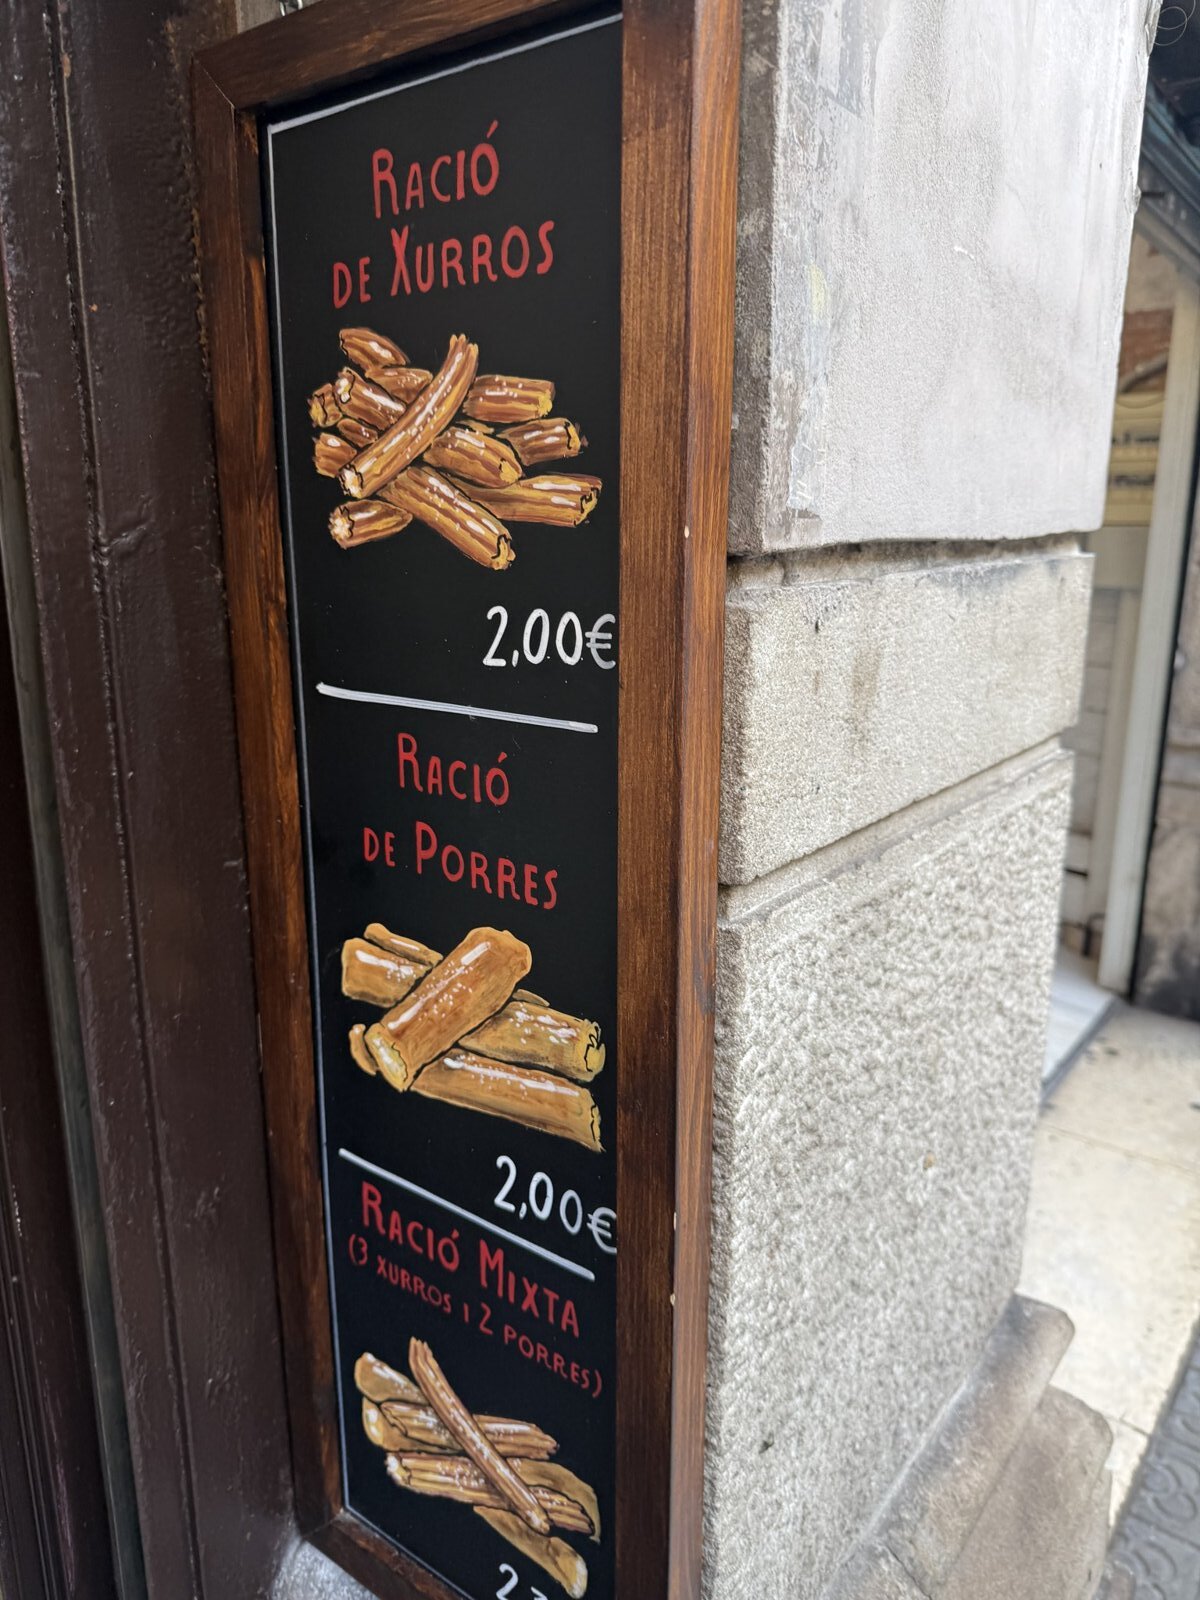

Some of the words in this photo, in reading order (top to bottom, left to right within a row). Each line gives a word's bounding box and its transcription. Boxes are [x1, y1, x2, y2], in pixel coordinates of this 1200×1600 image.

[372, 119, 500, 219] RACIÓ
[332, 256, 372, 309] DE
[390, 220, 555, 297] XURROS
[482, 605, 617, 670] 2,00€
[397, 732, 510, 806] RACIÓ
[363, 827, 396, 867] DE
[415, 821, 558, 910] PORRES
[493, 1154, 617, 1254] 2,00€
[361, 1181, 460, 1272] RACIÓ
[479, 1239, 580, 1338] MIXTA
[349, 1233, 368, 1266] (3
[376, 1255, 452, 1314] XURROS
[503, 1324, 603, 1398] PORRES)
